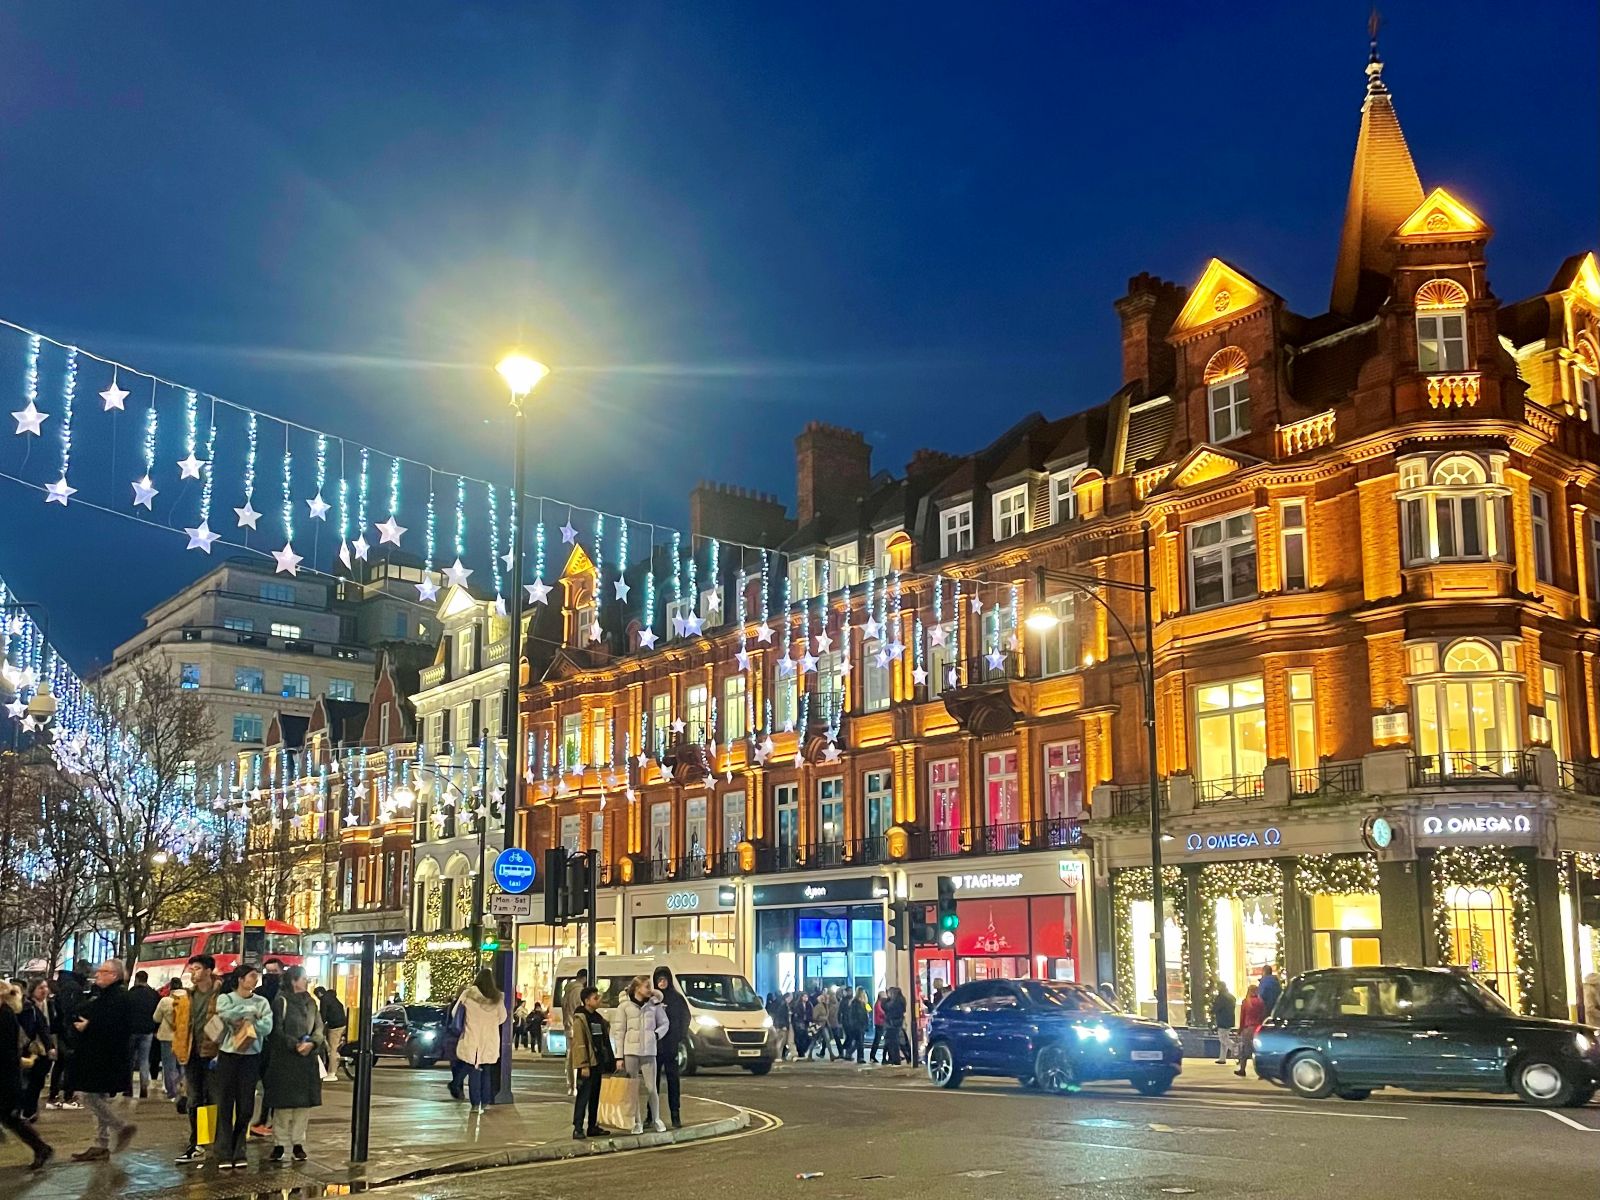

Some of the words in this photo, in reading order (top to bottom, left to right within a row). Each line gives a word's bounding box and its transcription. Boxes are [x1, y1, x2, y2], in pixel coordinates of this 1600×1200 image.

[1447, 816, 1511, 832] OMEGA
[1206, 832, 1260, 849] OMEGA
[804, 885, 827, 899] dyson
[495, 896, 510, 904] Mon
